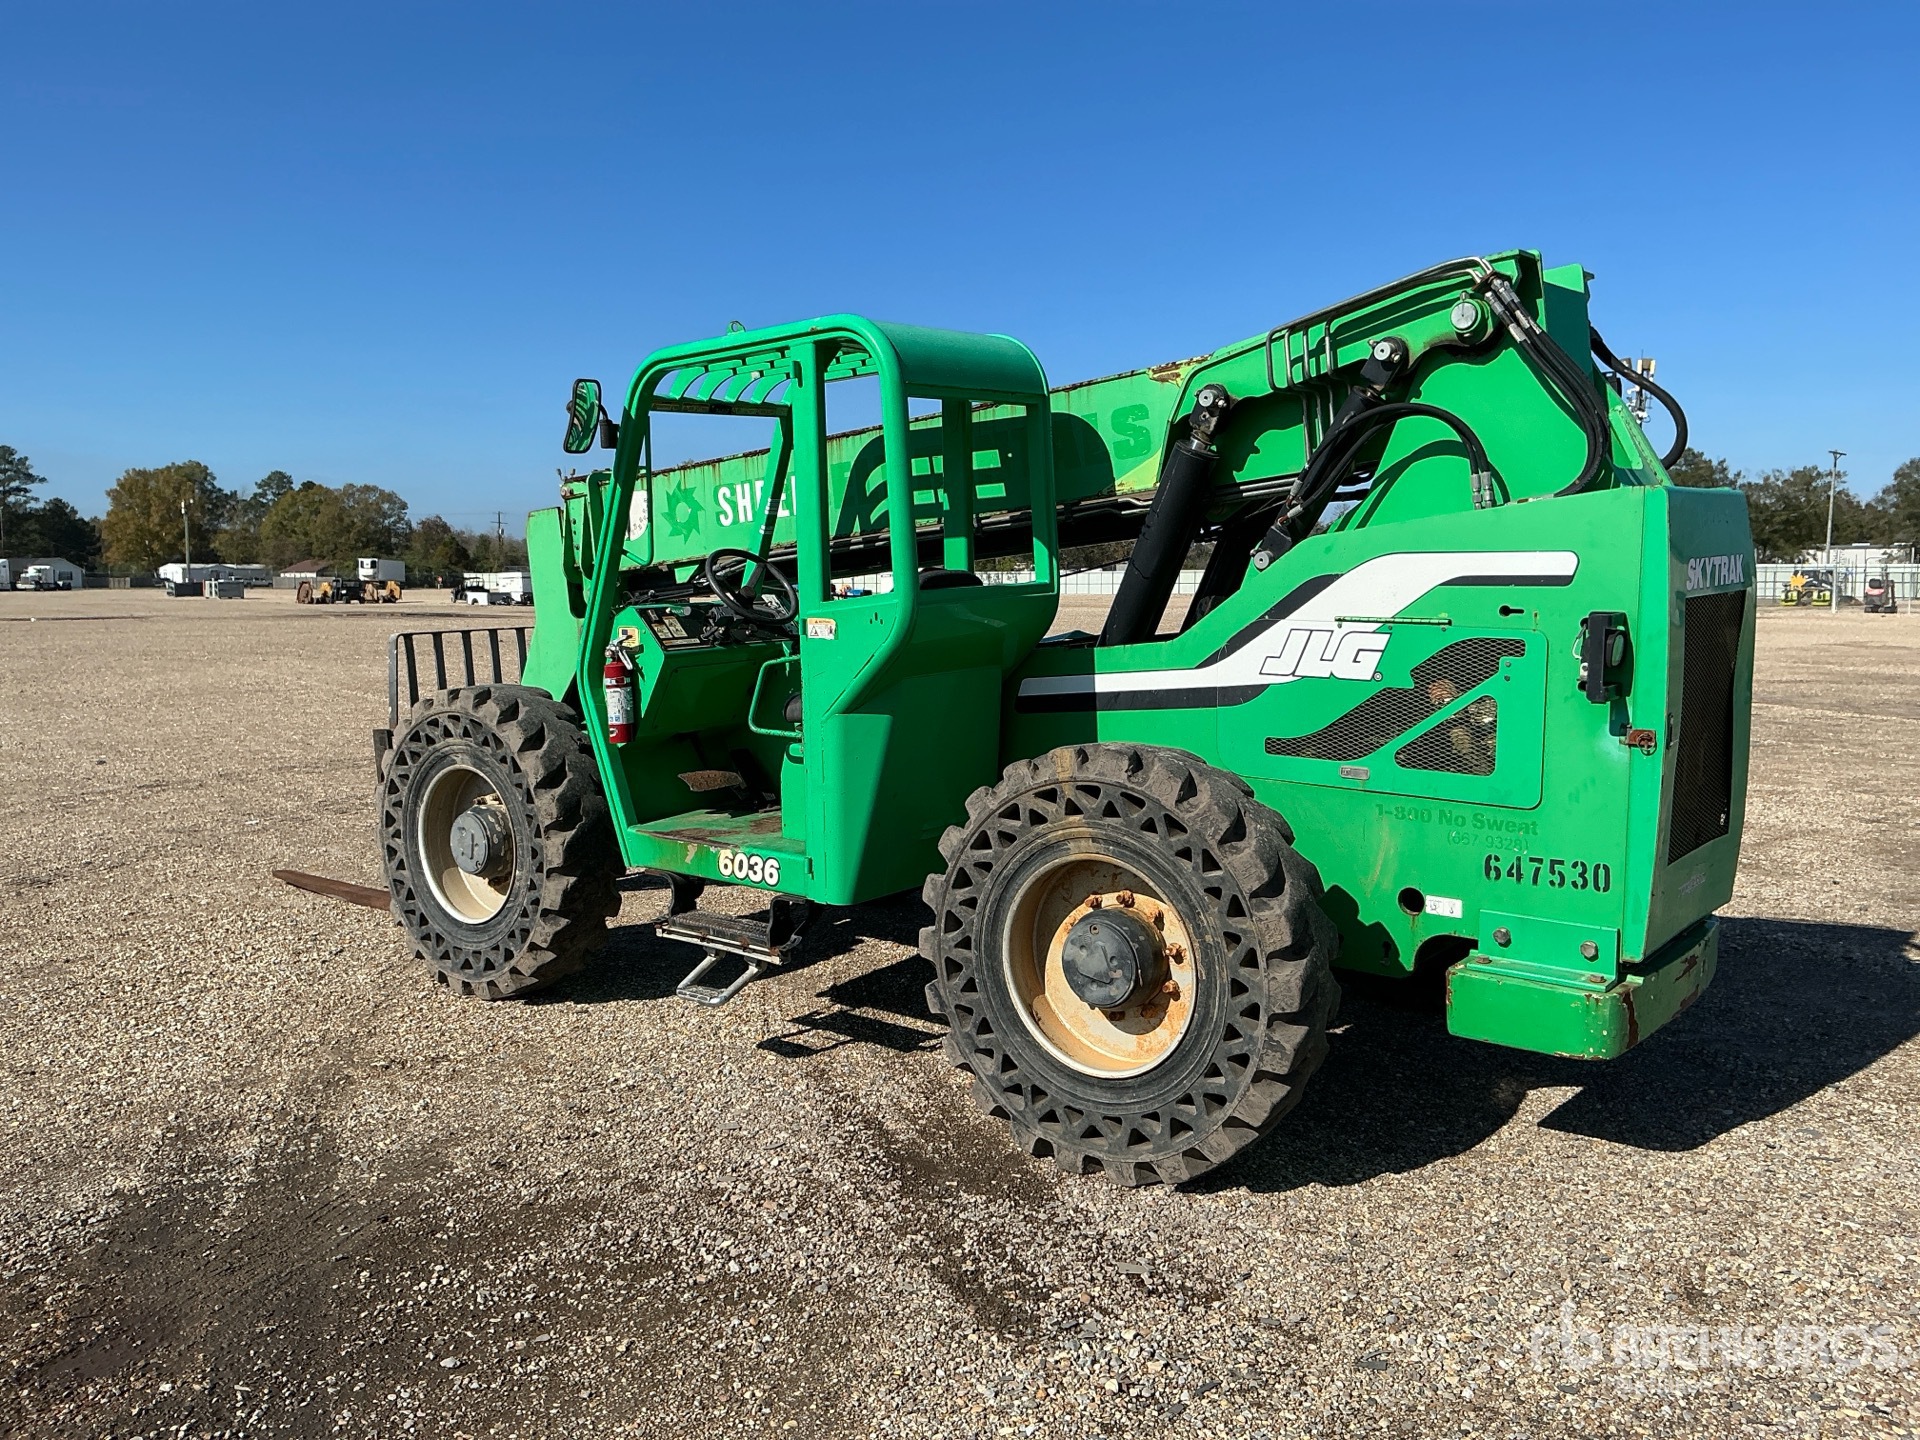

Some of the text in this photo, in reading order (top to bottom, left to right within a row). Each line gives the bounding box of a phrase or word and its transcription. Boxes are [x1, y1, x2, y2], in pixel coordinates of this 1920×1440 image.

[1686, 553, 1745, 591] SKYTRAK
[1259, 628, 1393, 682] JLG
[1376, 803, 1539, 836] 1-800 No Sweat
[717, 849, 781, 887] 6036
[1484, 853, 1612, 893] 647530
